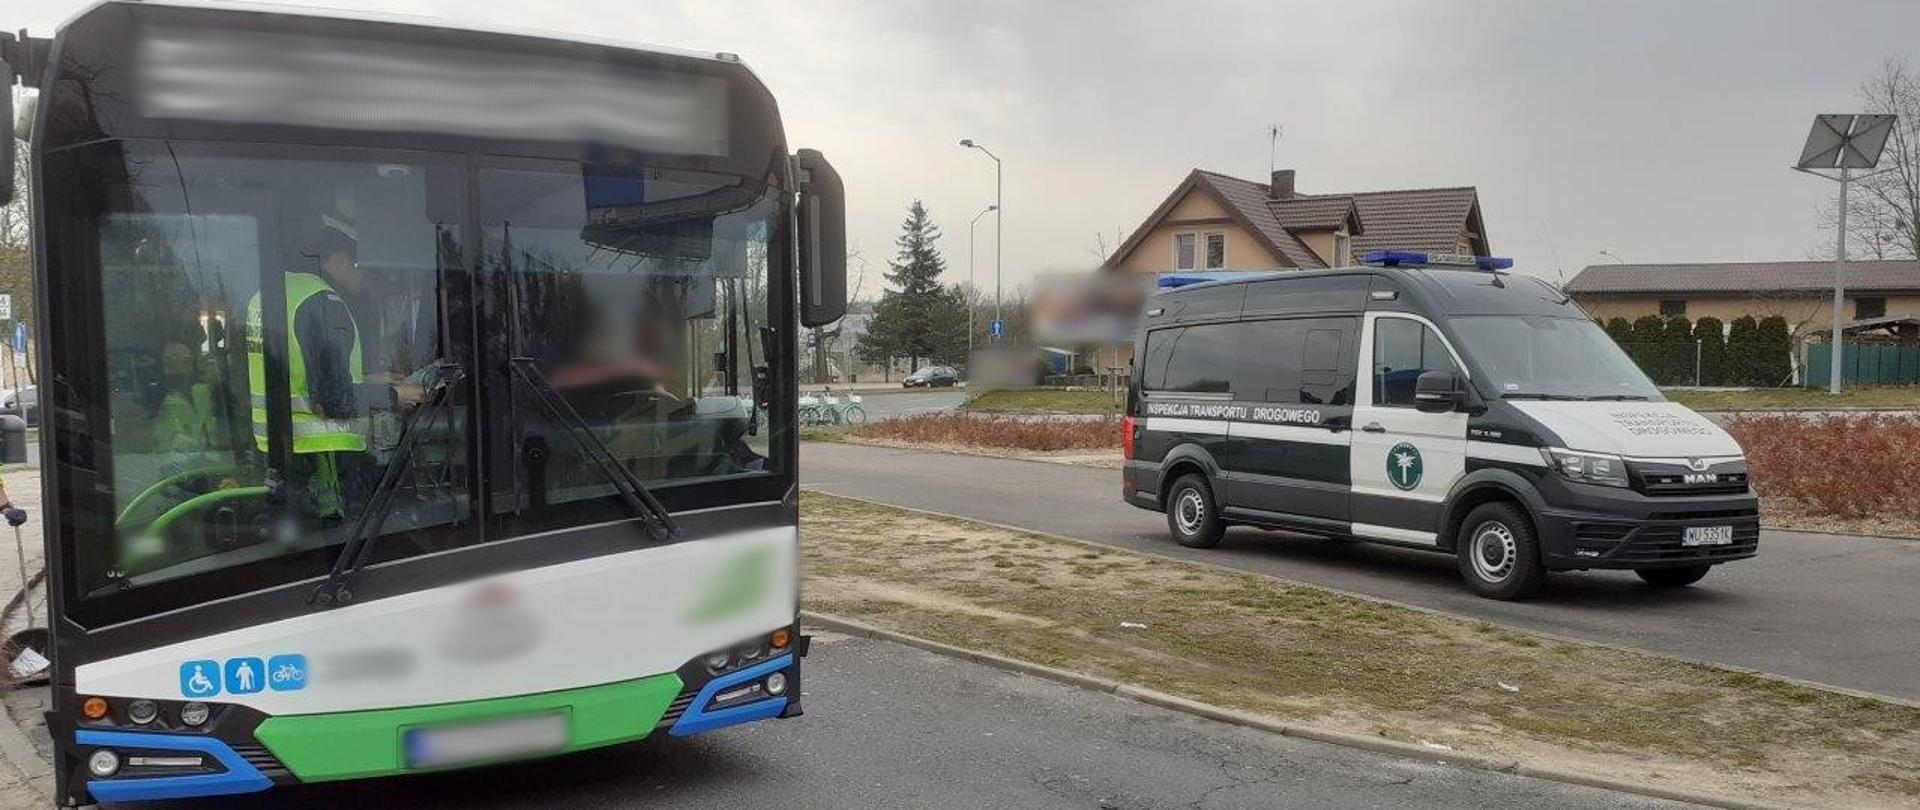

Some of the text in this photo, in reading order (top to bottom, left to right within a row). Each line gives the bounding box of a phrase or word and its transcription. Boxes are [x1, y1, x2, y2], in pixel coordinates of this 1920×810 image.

[1147, 403, 1320, 423] INSPEKCJA TRANSPORTU DROGOWEGO
[1683, 474, 1718, 484] MAN
